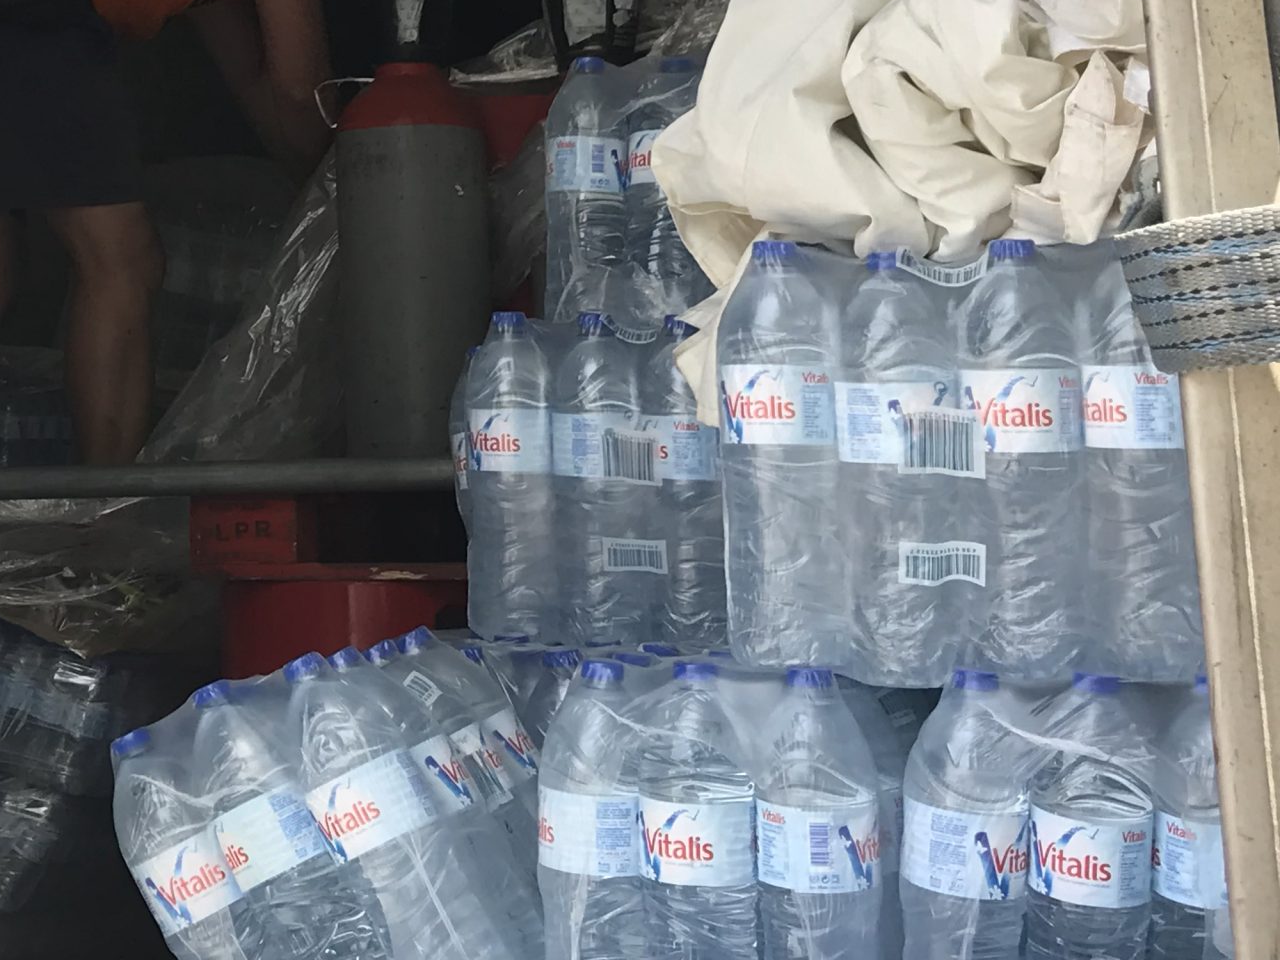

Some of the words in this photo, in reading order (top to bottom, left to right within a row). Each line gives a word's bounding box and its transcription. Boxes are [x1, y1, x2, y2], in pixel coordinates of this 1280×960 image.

[1134, 372, 1169, 385] Vitalis
[726, 392, 796, 420] Vitalis
[976, 398, 1053, 428] Vitalis
[469, 430, 521, 453] Vitalis
[317, 800, 382, 841] Vitalis
[646, 827, 714, 861] Vitalis
[993, 843, 1028, 874] Vita
[1038, 839, 1113, 882] Vitalis
[156, 863, 226, 905] Vitalis
